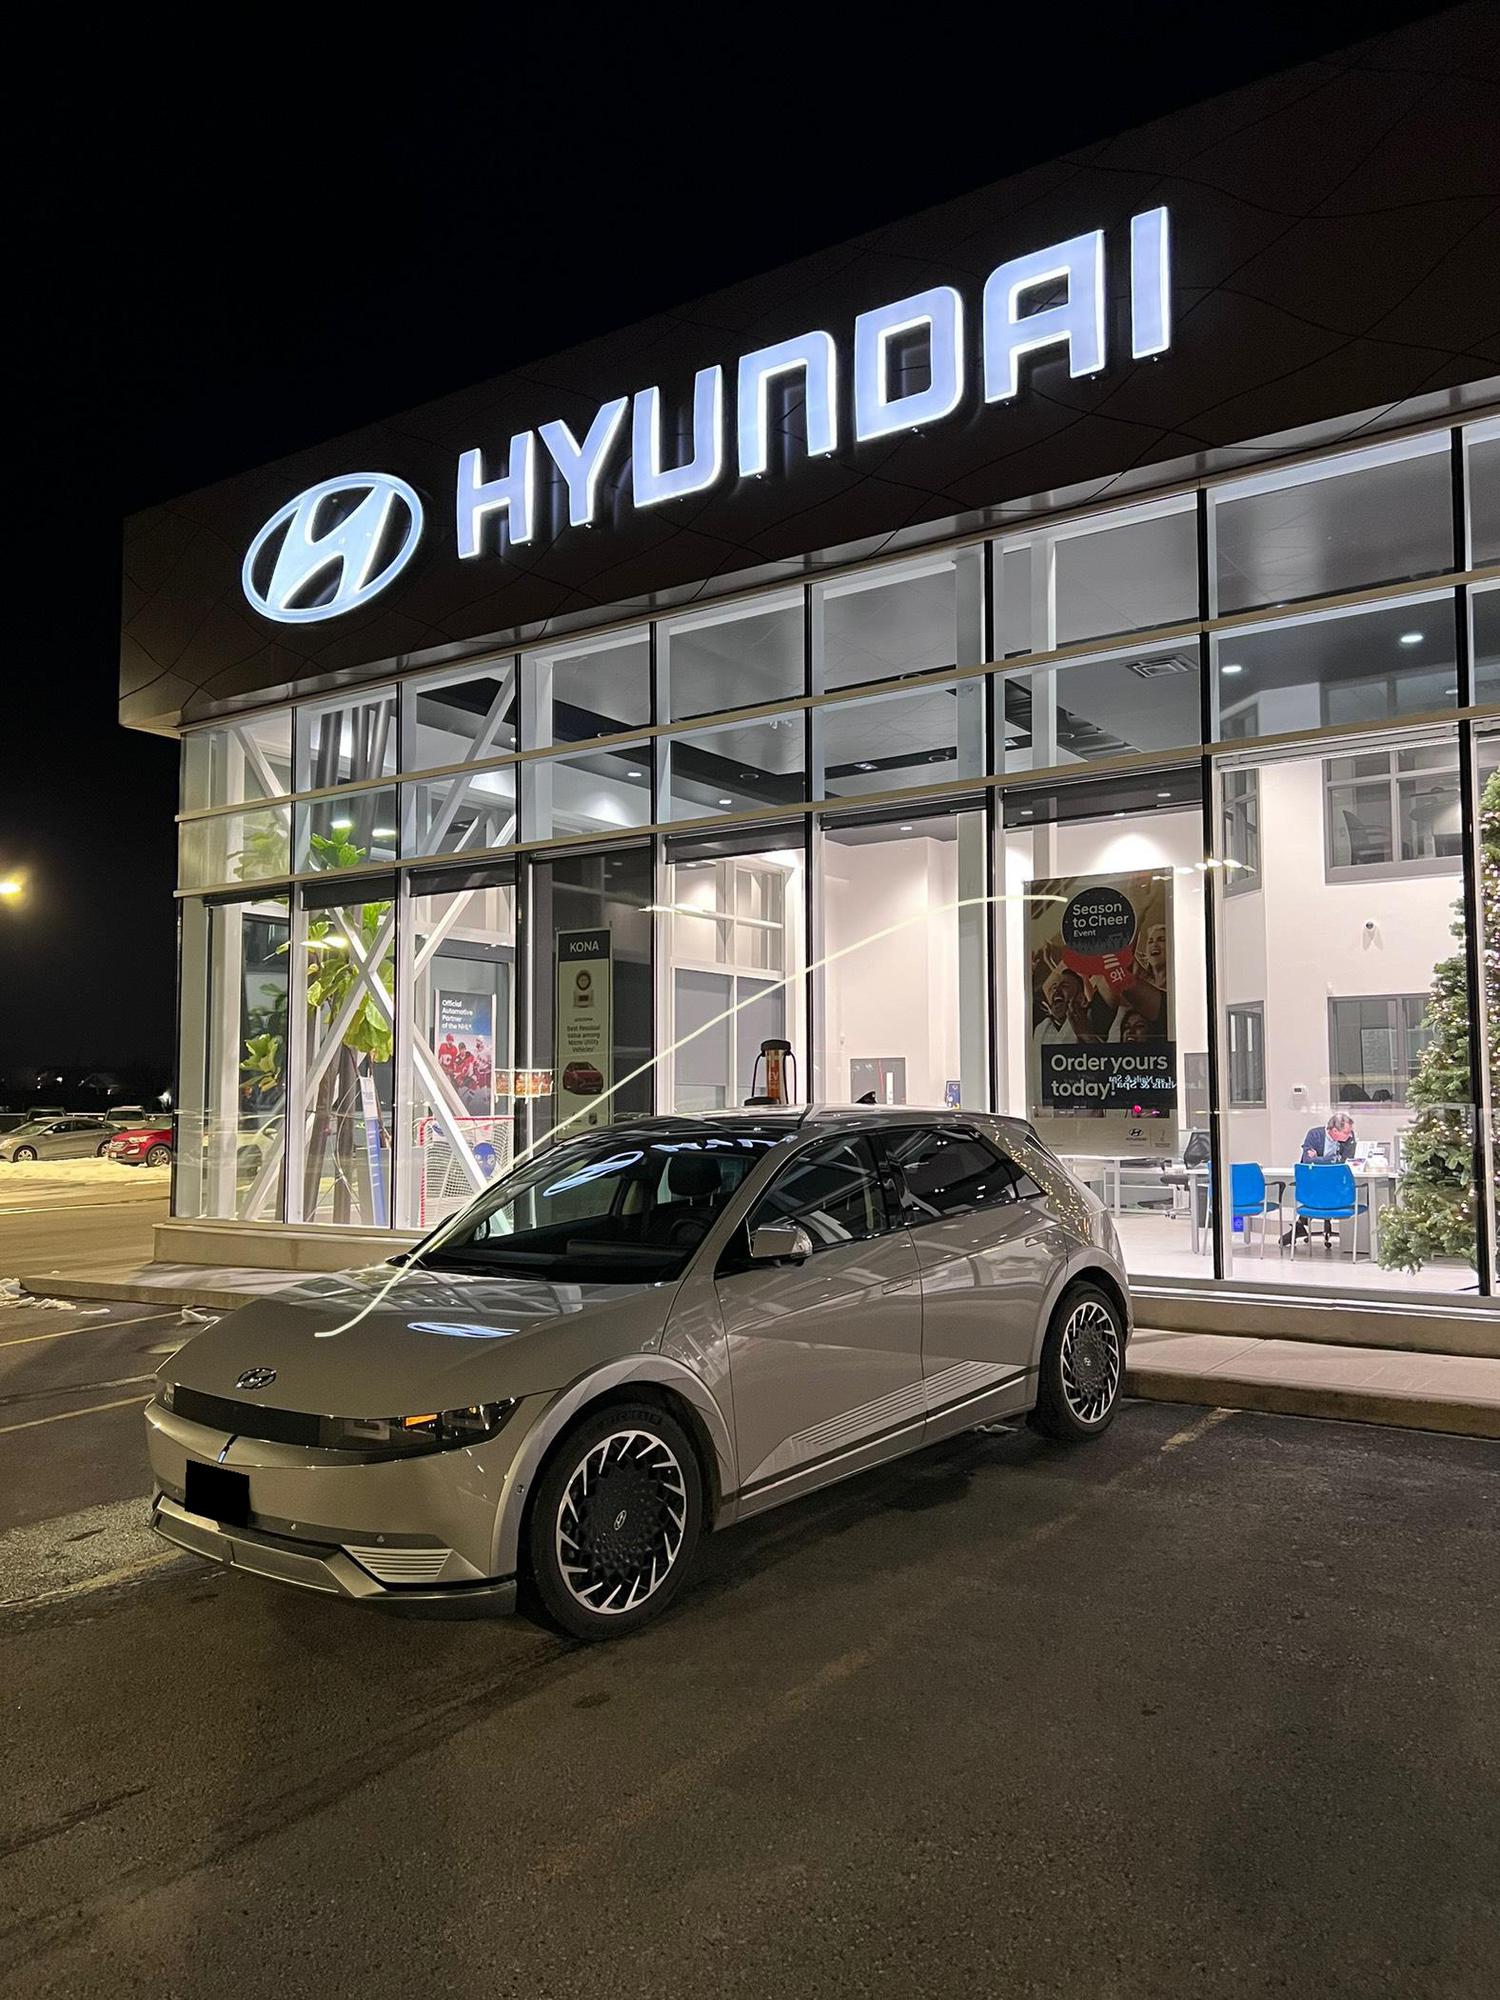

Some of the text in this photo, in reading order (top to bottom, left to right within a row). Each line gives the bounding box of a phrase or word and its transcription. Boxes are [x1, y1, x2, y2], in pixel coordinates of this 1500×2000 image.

[456, 205, 1170, 560] HYUNDAI
[1072, 903, 1122, 916] Season
[1072, 914, 1129, 928] to Cheer
[1073, 929, 1097, 938] Event
[569, 940, 600, 953] KONA
[1051, 1053, 1168, 1074] Order yours
[1051, 1079, 1116, 1100] today!
